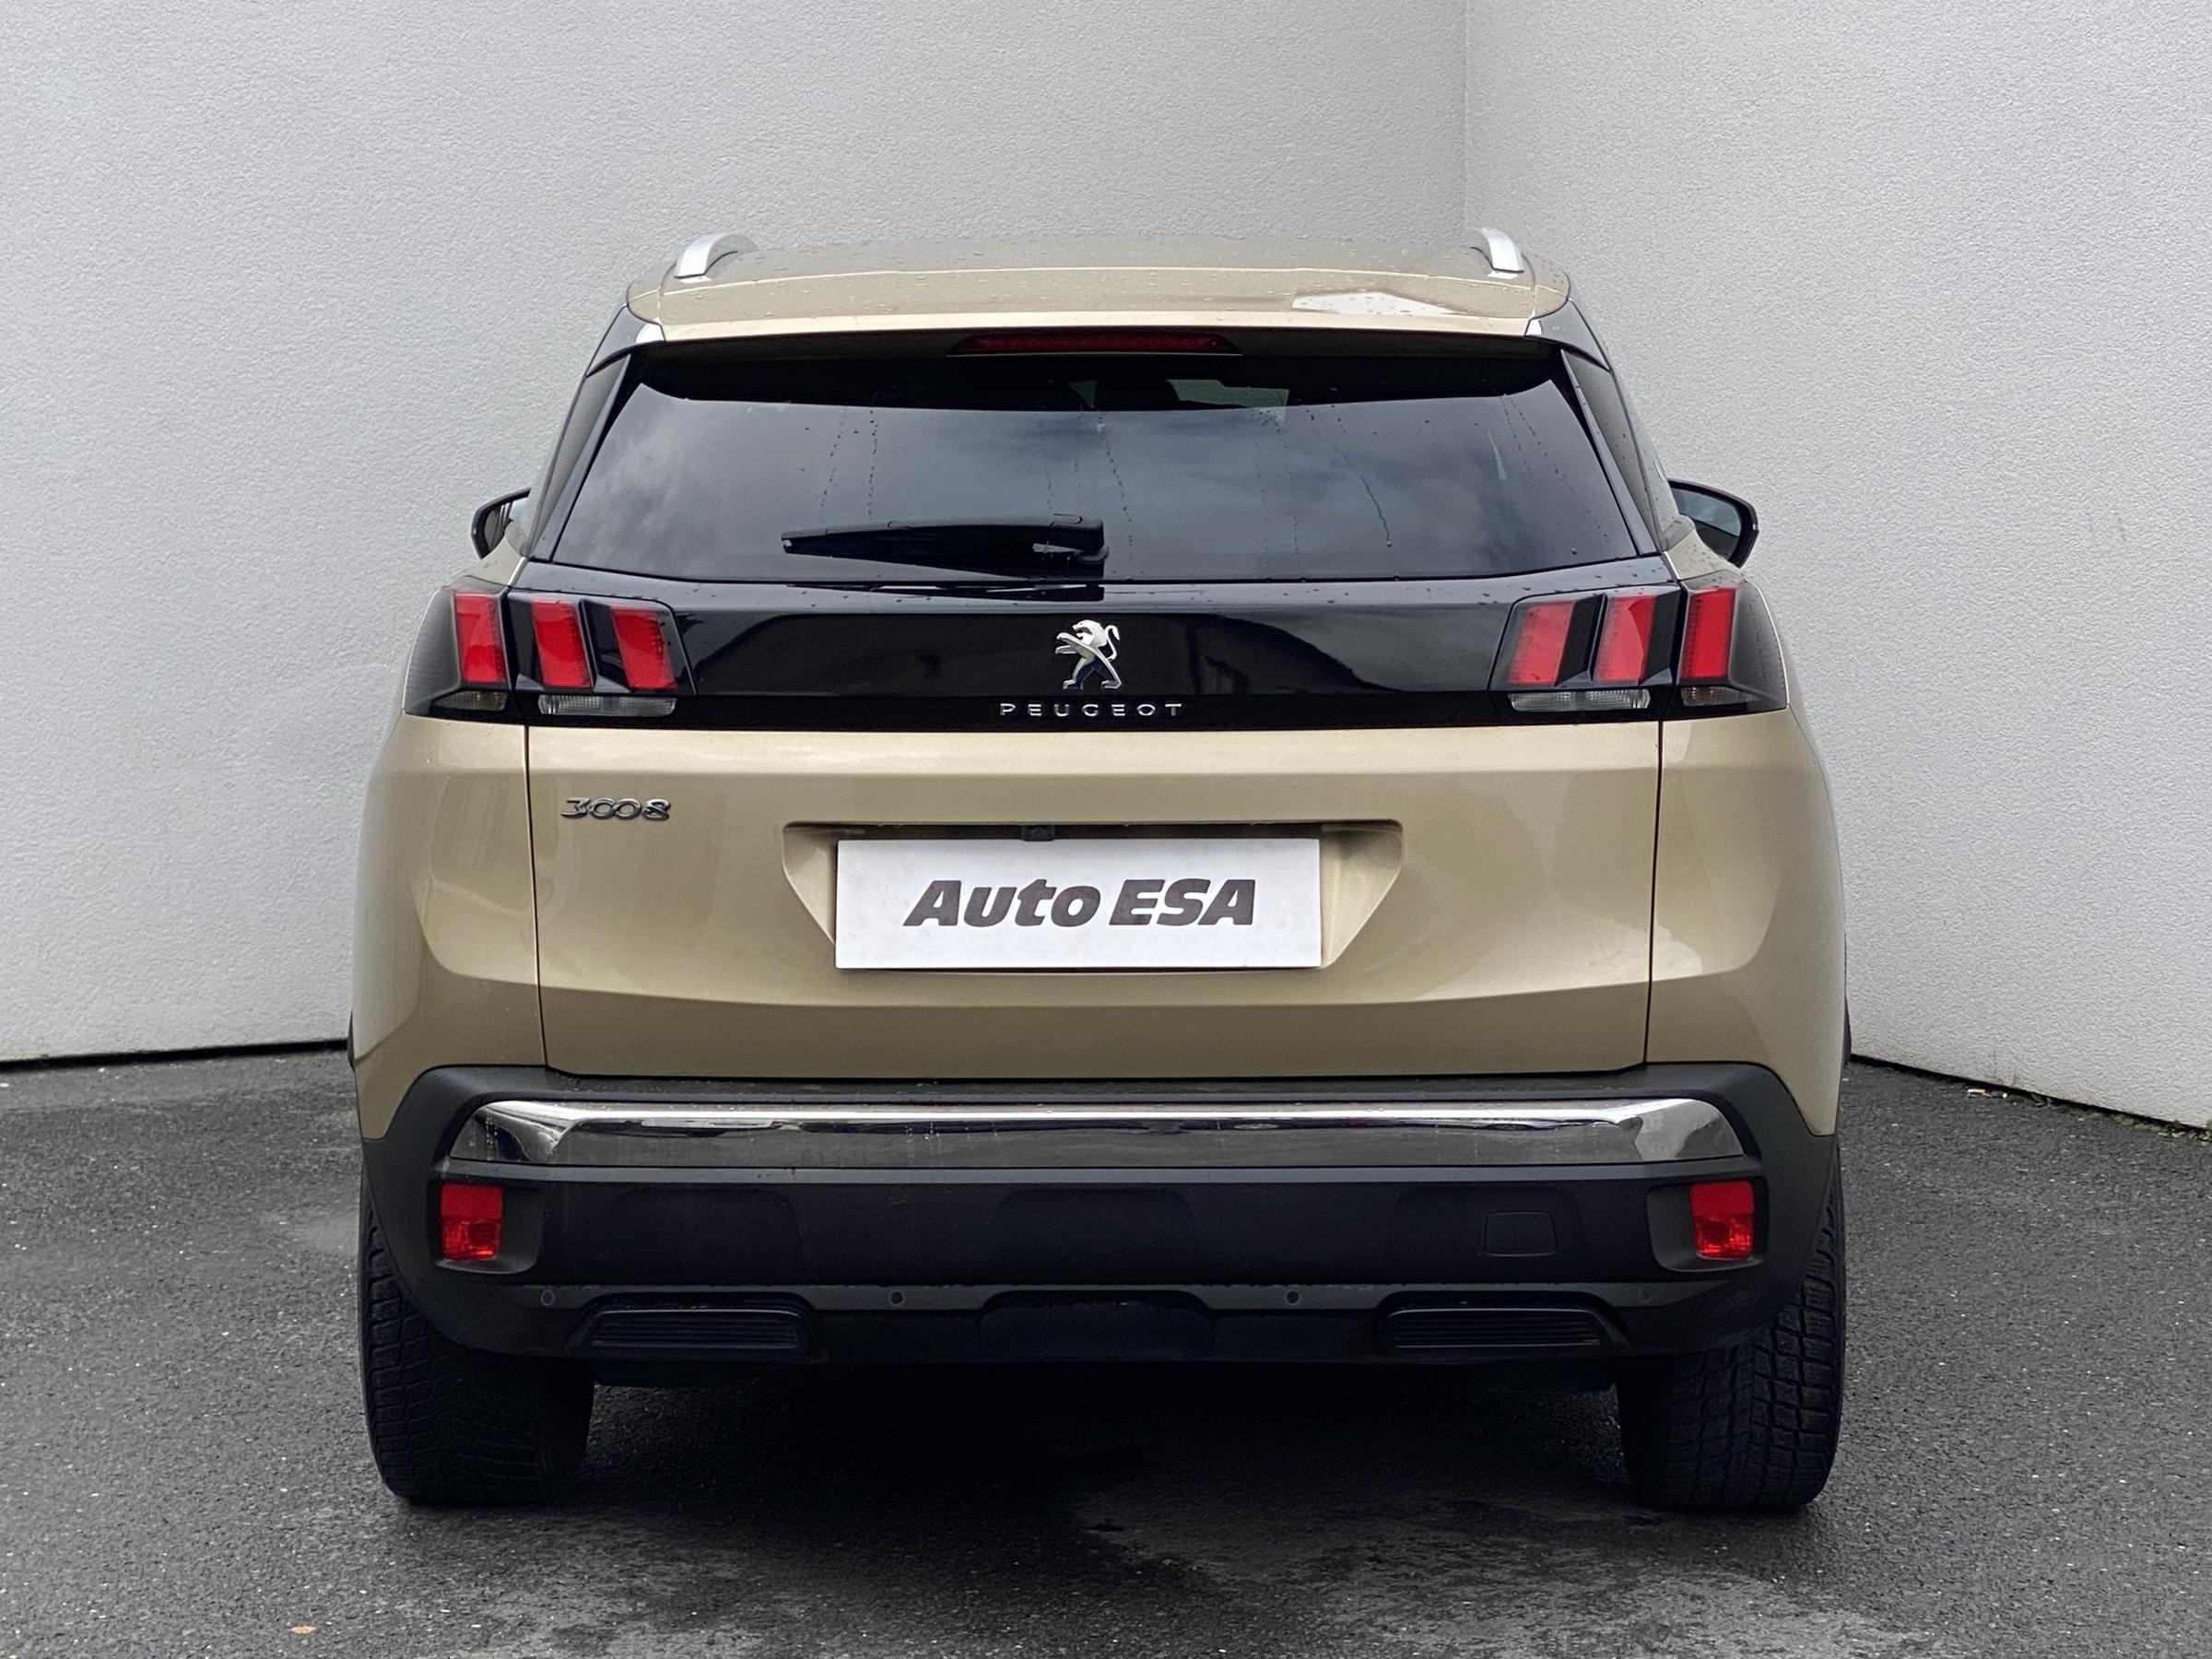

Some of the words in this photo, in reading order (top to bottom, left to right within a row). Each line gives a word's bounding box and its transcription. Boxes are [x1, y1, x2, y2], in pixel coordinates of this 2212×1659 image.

[999, 703, 1182, 717] PEUGEOT
[560, 797, 671, 821] 3008
[902, 878, 1101, 927] Auto
[1109, 877, 1256, 926] ESA
